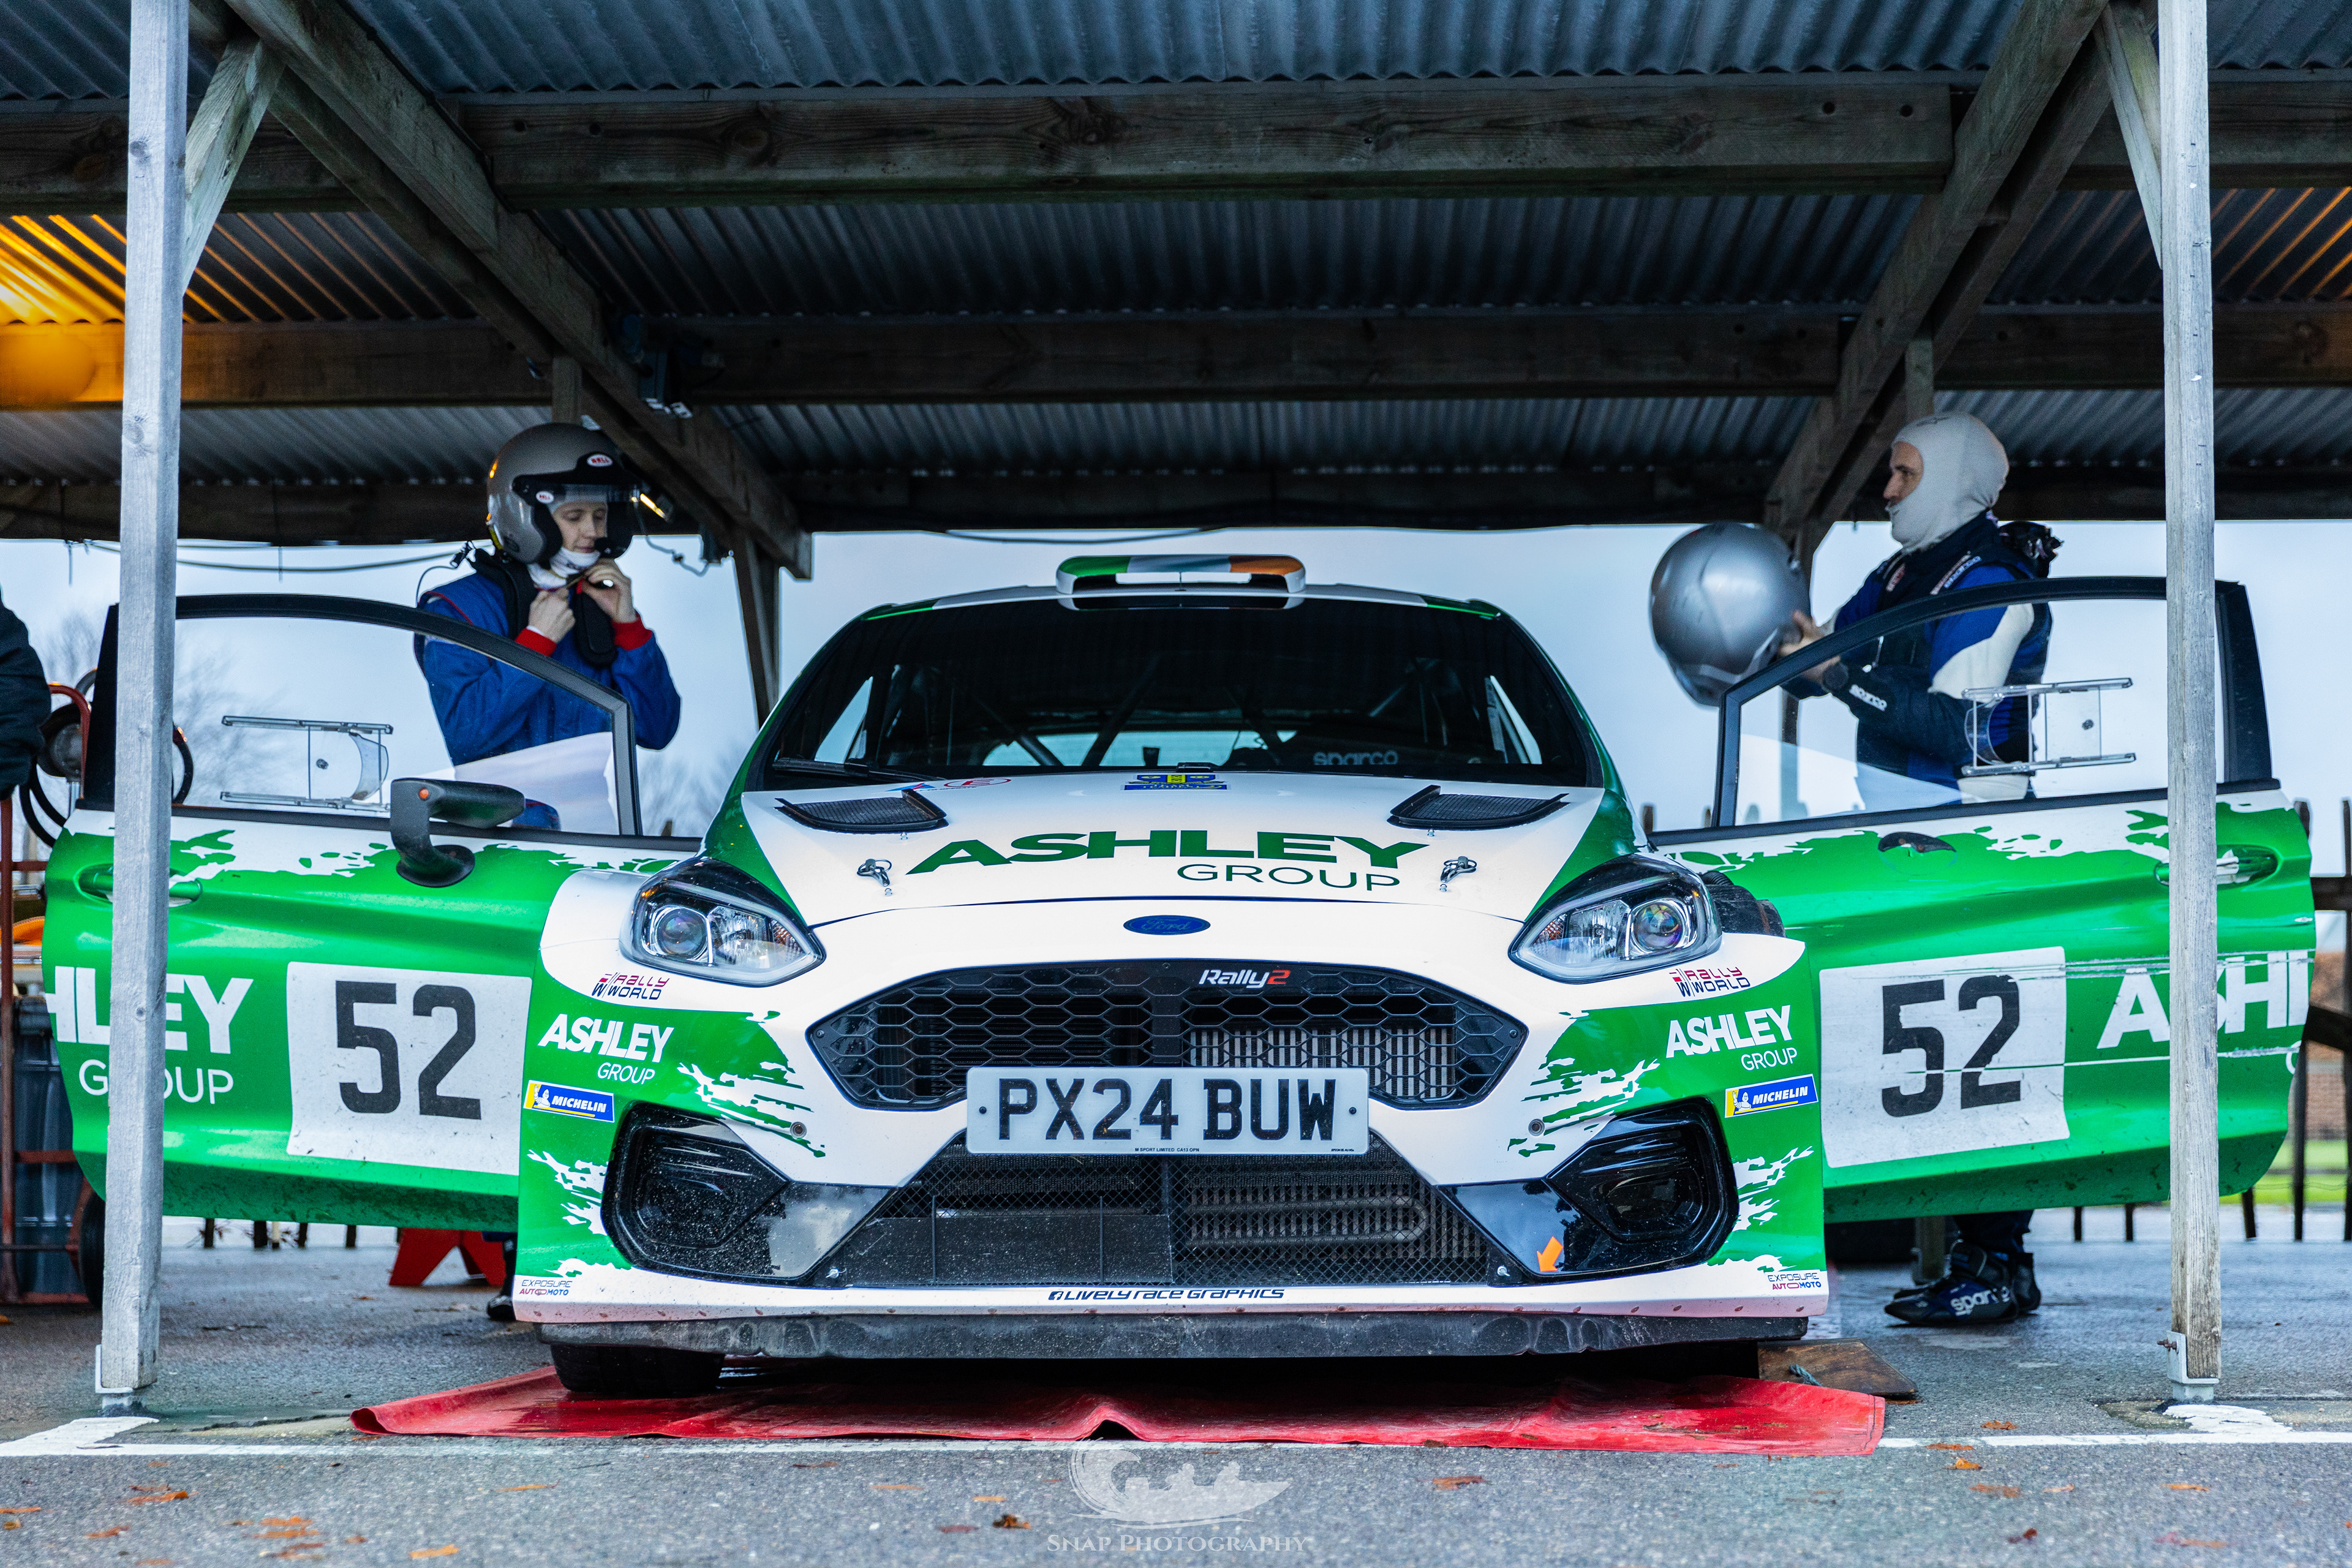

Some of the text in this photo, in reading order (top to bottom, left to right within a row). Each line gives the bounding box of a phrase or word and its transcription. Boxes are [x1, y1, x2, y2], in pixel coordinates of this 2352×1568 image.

[906, 830, 1430, 875] ASHLEY
[1177, 864, 1400, 891] GROUP
[1141, 919, 1191, 931] Ford
[1199, 969, 1291, 989] Rally2
[1692, 977, 1751, 993] WORLD
[608, 986, 662, 1000] WORLD
[537, 1014, 674, 1063] ASHLEY
[1666, 1005, 1792, 1058] ASHLEY
[336, 981, 481, 1120] 52
[1882, 974, 2021, 1117] 52
[1741, 1047, 1798, 1071] GROUP
[79, 1059, 234, 1104] GUP
[597, 1062, 655, 1085] GROUP
[551, 1096, 607, 1113] MICHELIN
[1752, 1086, 1808, 1105] MICHELIN
[999, 1078, 1336, 1140] PX24 BUW
[1768, 1273, 1819, 1281] EXPOSURE
